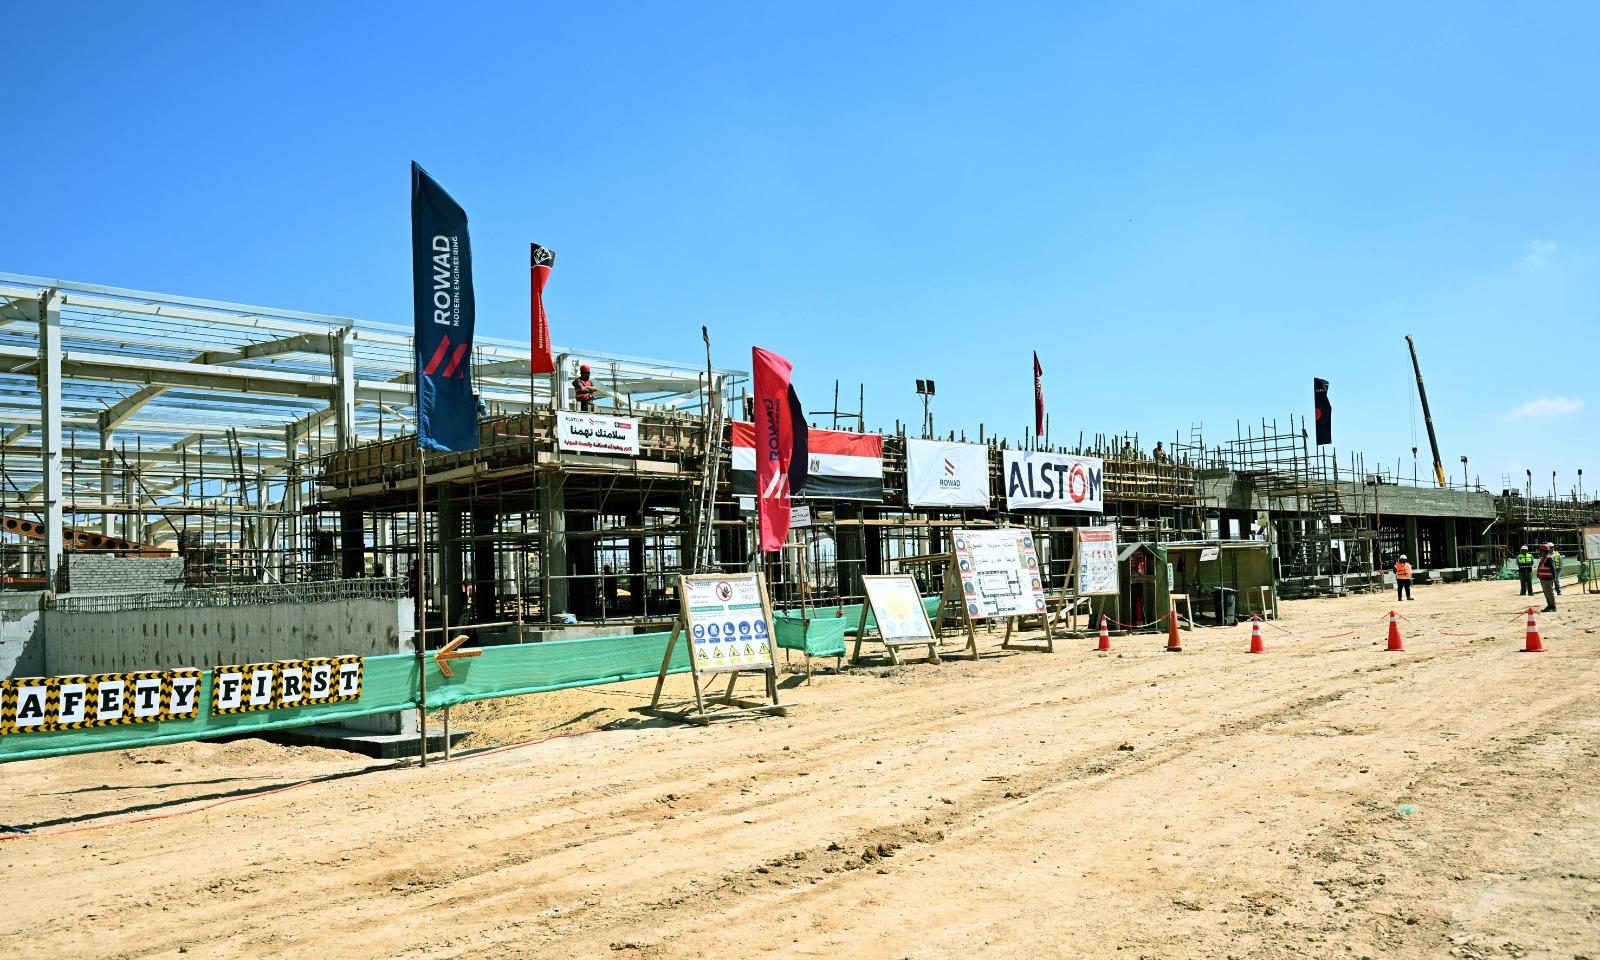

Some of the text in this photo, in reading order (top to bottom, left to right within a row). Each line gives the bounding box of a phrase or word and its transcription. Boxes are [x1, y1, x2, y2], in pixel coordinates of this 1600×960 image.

[433, 235, 450, 325] ROWAD
[570, 426, 626, 440] سلامتك تهمنا
[763, 398, 780, 461] ROWAD
[1008, 462, 1102, 504] ALSTOM
[18, 670, 357, 718] AFETY FIRST
